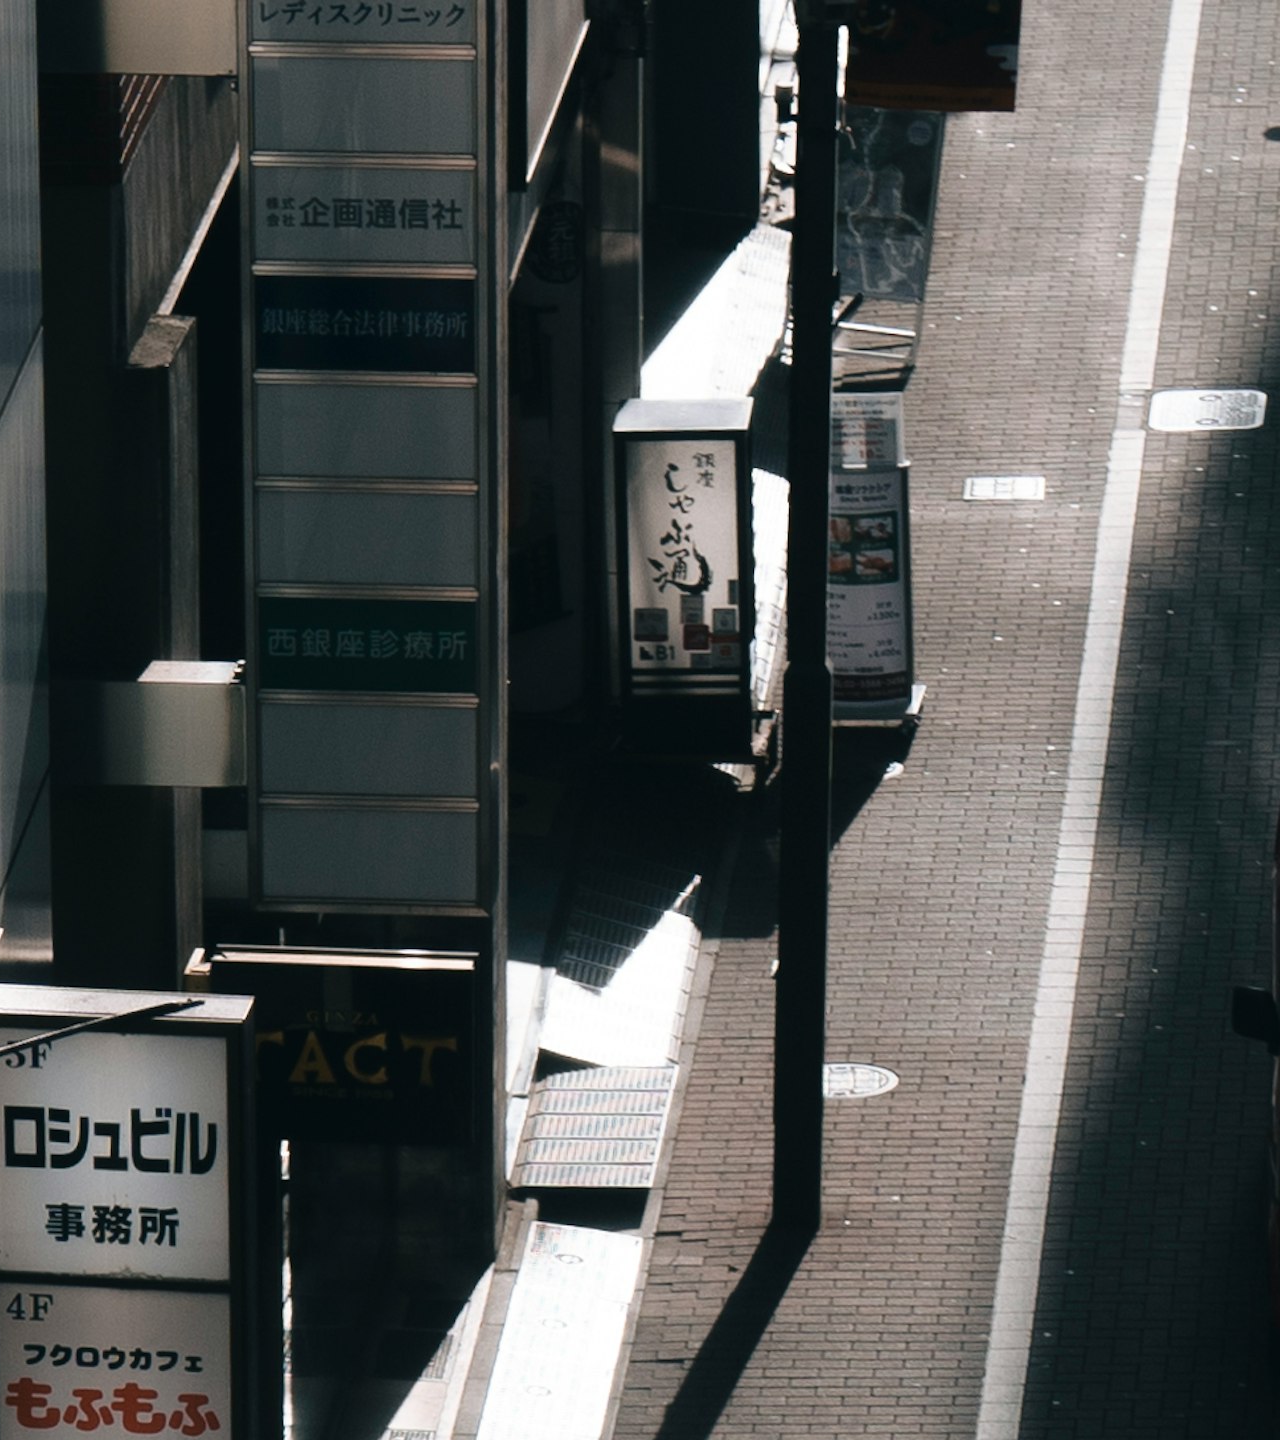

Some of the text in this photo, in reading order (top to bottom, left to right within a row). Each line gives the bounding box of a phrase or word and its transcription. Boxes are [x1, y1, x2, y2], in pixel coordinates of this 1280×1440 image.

[259, 2, 465, 28] レディスクリニック
[299, 197, 464, 230] 企画通信社
[261, 306, 469, 340] 銀座総合法律事務所
[266, 626, 468, 661] 西銀座診療所
[656, 645, 677, 661] B1
[306, 1010, 380, 1027] GINZA
[3, 1106, 218, 1176] ロシュビル
[44, 1203, 180, 1247] 事務所
[6, 1293, 55, 1323] 4F
[22, 1342, 205, 1374] フクロウカフェ
[5, 1377, 222, 1437] もふもふ
